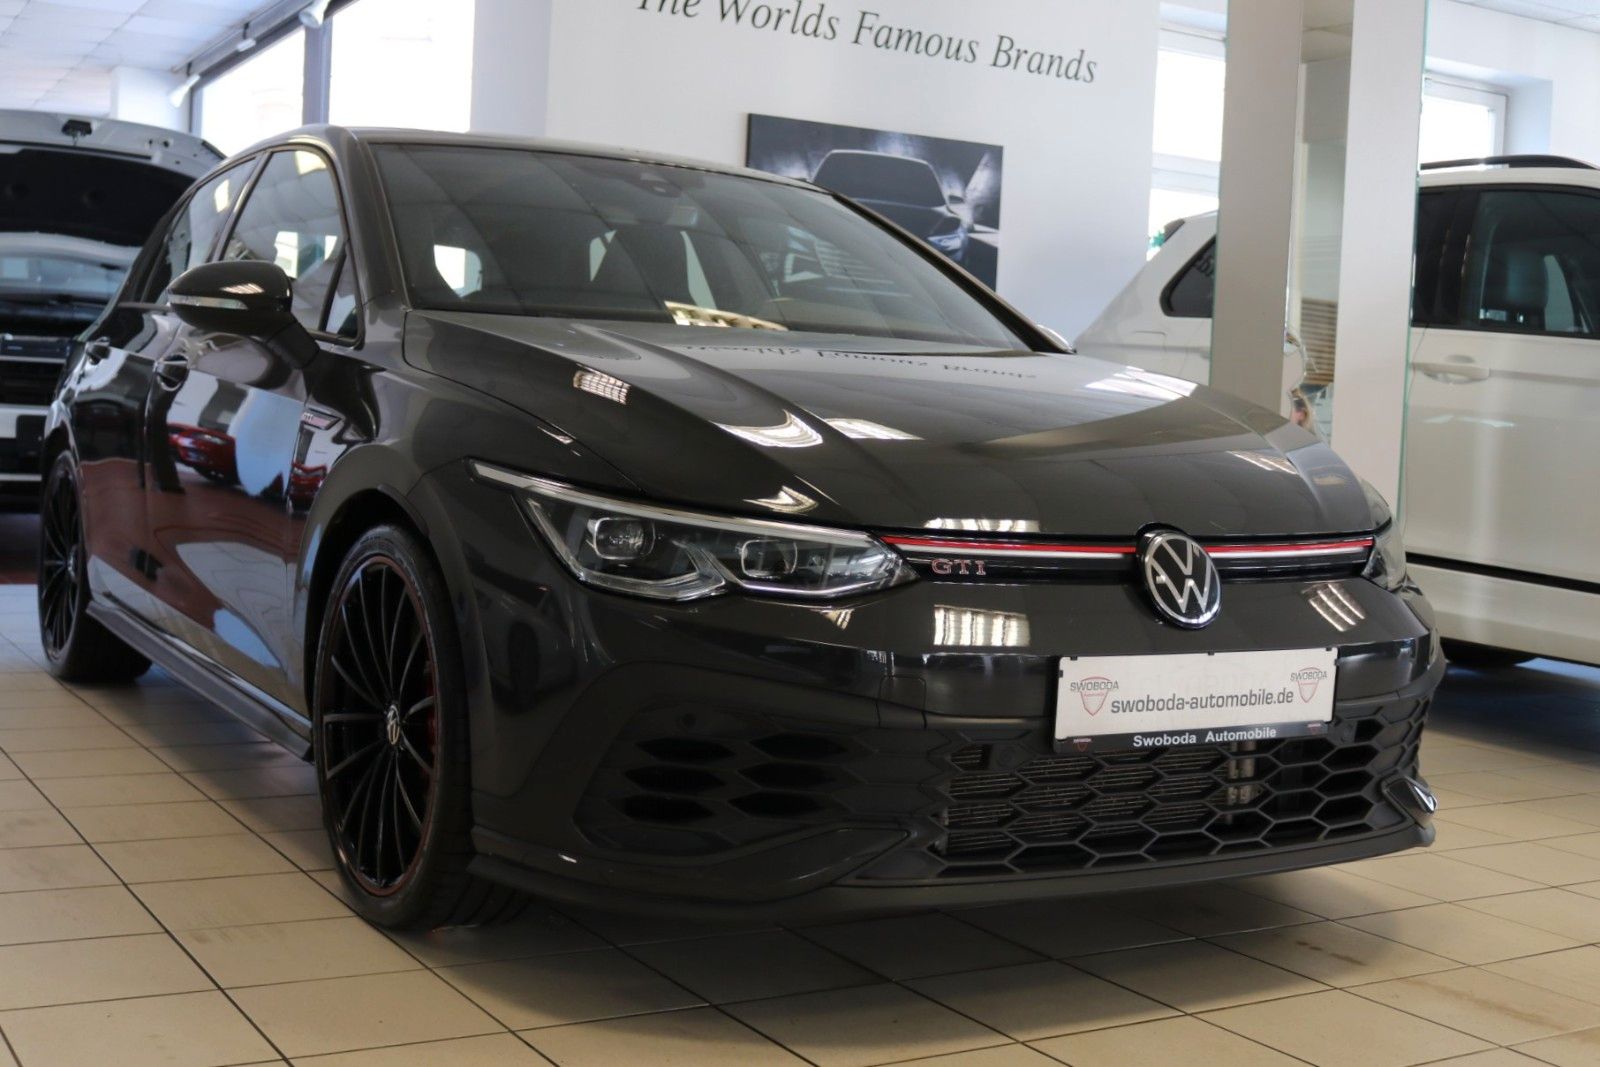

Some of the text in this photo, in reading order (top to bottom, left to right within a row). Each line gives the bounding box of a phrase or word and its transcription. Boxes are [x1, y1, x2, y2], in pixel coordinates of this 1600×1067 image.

[719, 0, 1097, 83] Worlds Famous Brands
[931, 559, 986, 576] GTI
[1070, 680, 1119, 692] SWOBODA
[1110, 687, 1294, 714] swoboda-automobile.de
[1132, 726, 1277, 748] Swoboda Automobile
